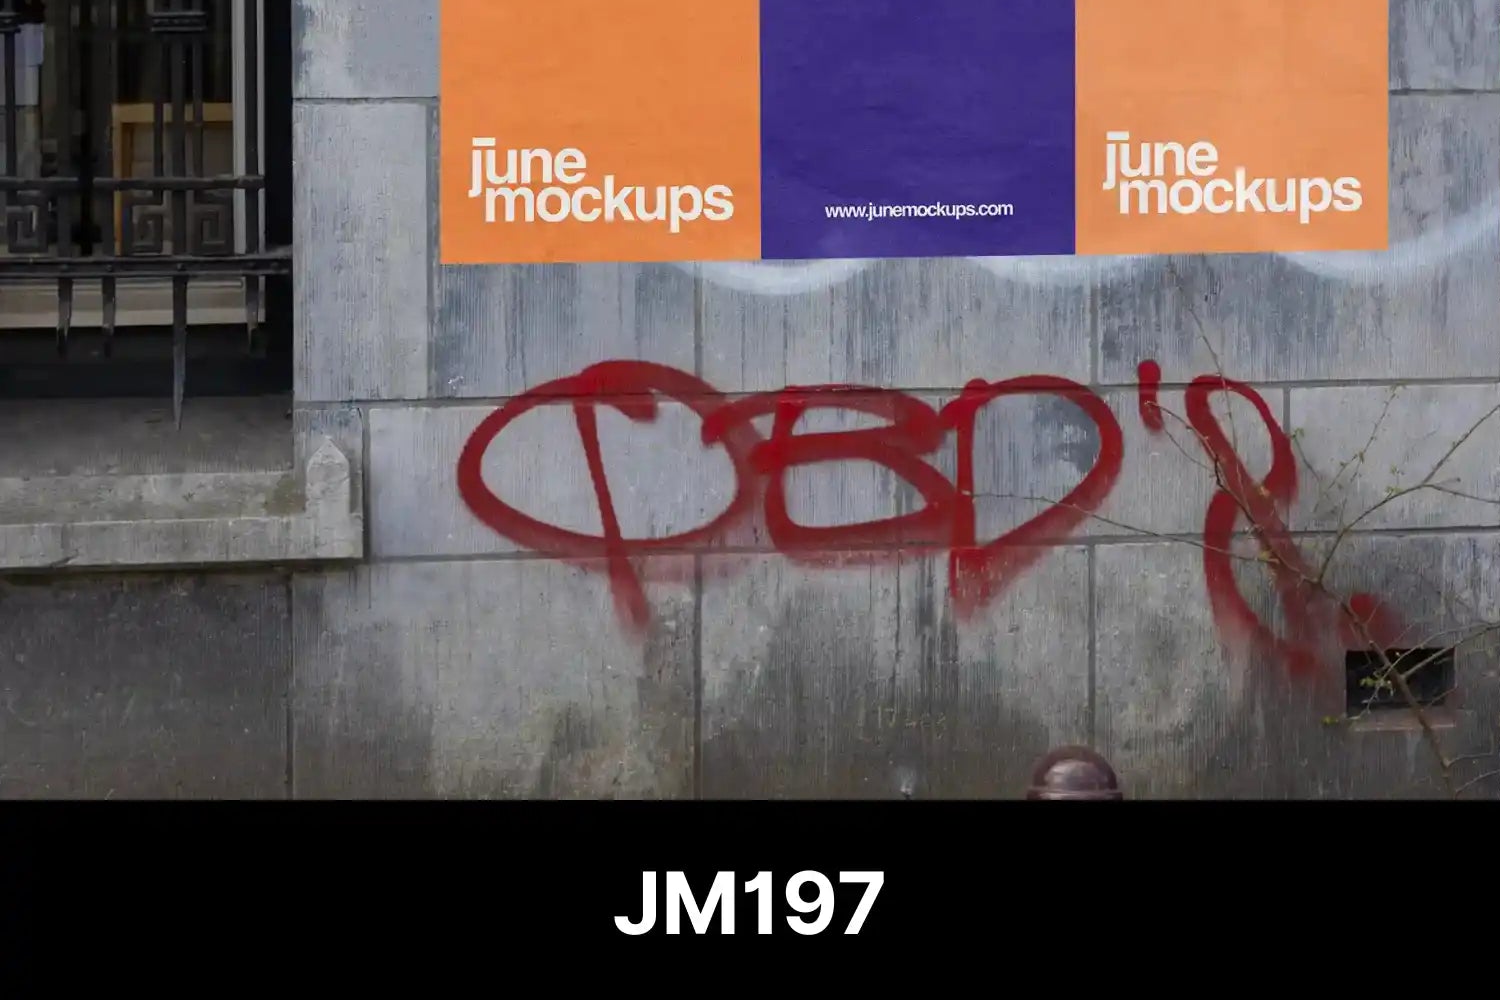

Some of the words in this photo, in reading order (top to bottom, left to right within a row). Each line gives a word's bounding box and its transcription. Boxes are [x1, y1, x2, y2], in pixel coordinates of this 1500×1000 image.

[469, 138, 586, 197] june
[1103, 132, 1217, 189] june
[486, 176, 733, 232] mockups
[825, 202, 1013, 221] www.junemockups.com
[1120, 169, 1362, 223] mockups
